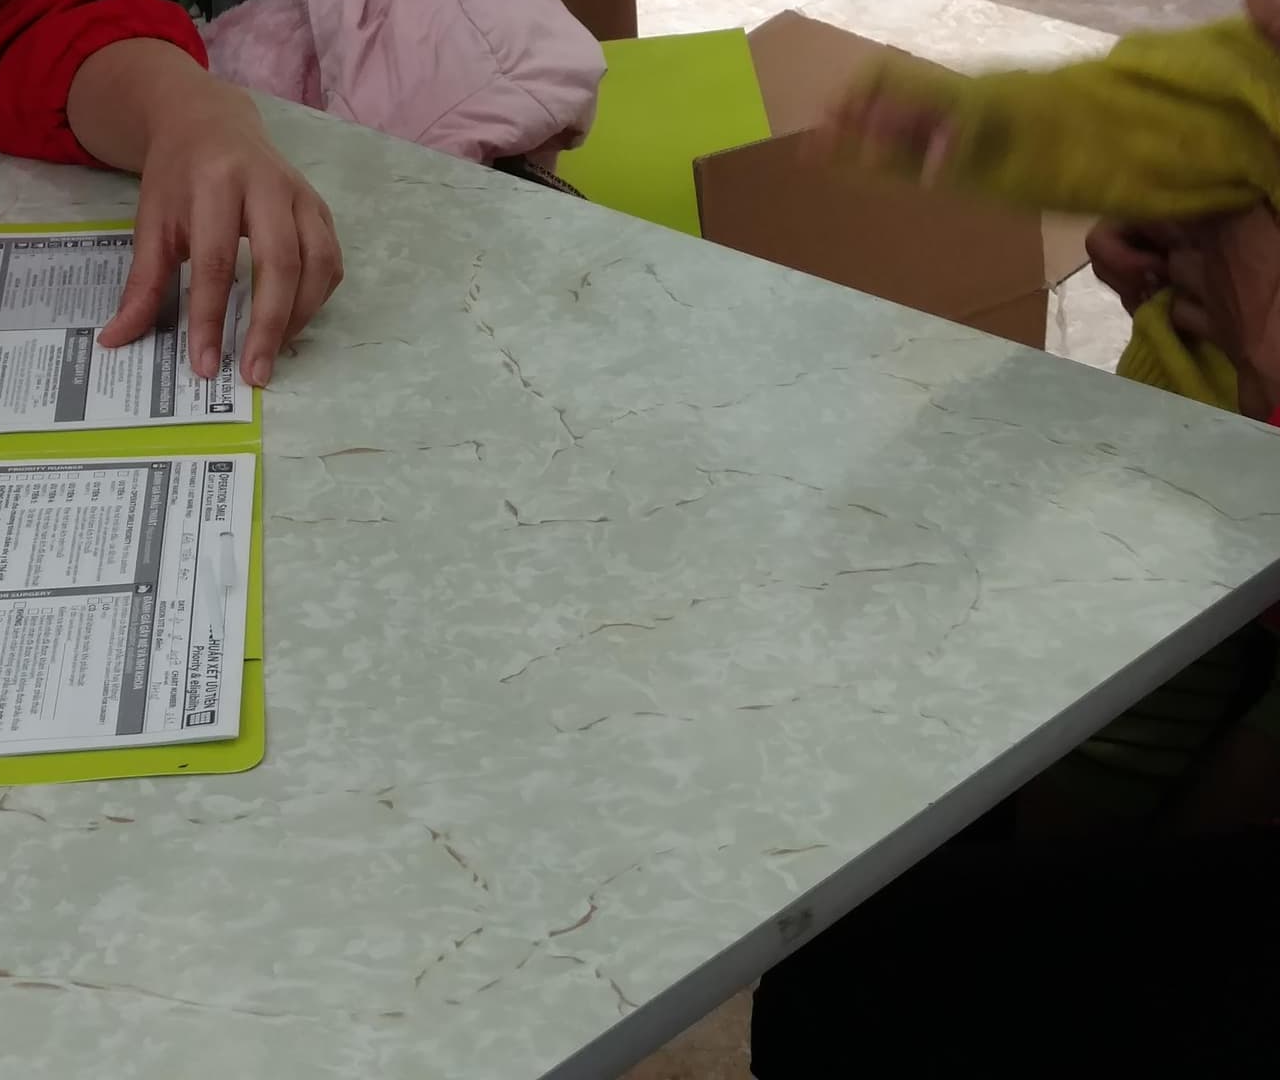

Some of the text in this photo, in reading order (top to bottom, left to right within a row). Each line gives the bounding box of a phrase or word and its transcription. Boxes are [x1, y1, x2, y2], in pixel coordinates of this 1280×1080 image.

[221, 352, 234, 372] HÔNG
[221, 373, 231, 382] TIN
[214, 473, 229, 520] OPERATION SMILE
[10, 590, 52, 599] SURGERY
[188, 645, 203, 670] Priority
[206, 635, 222, 662] HUẨN
[205, 663, 220, 679] XÉT
[184, 680, 201, 711] eligibility
